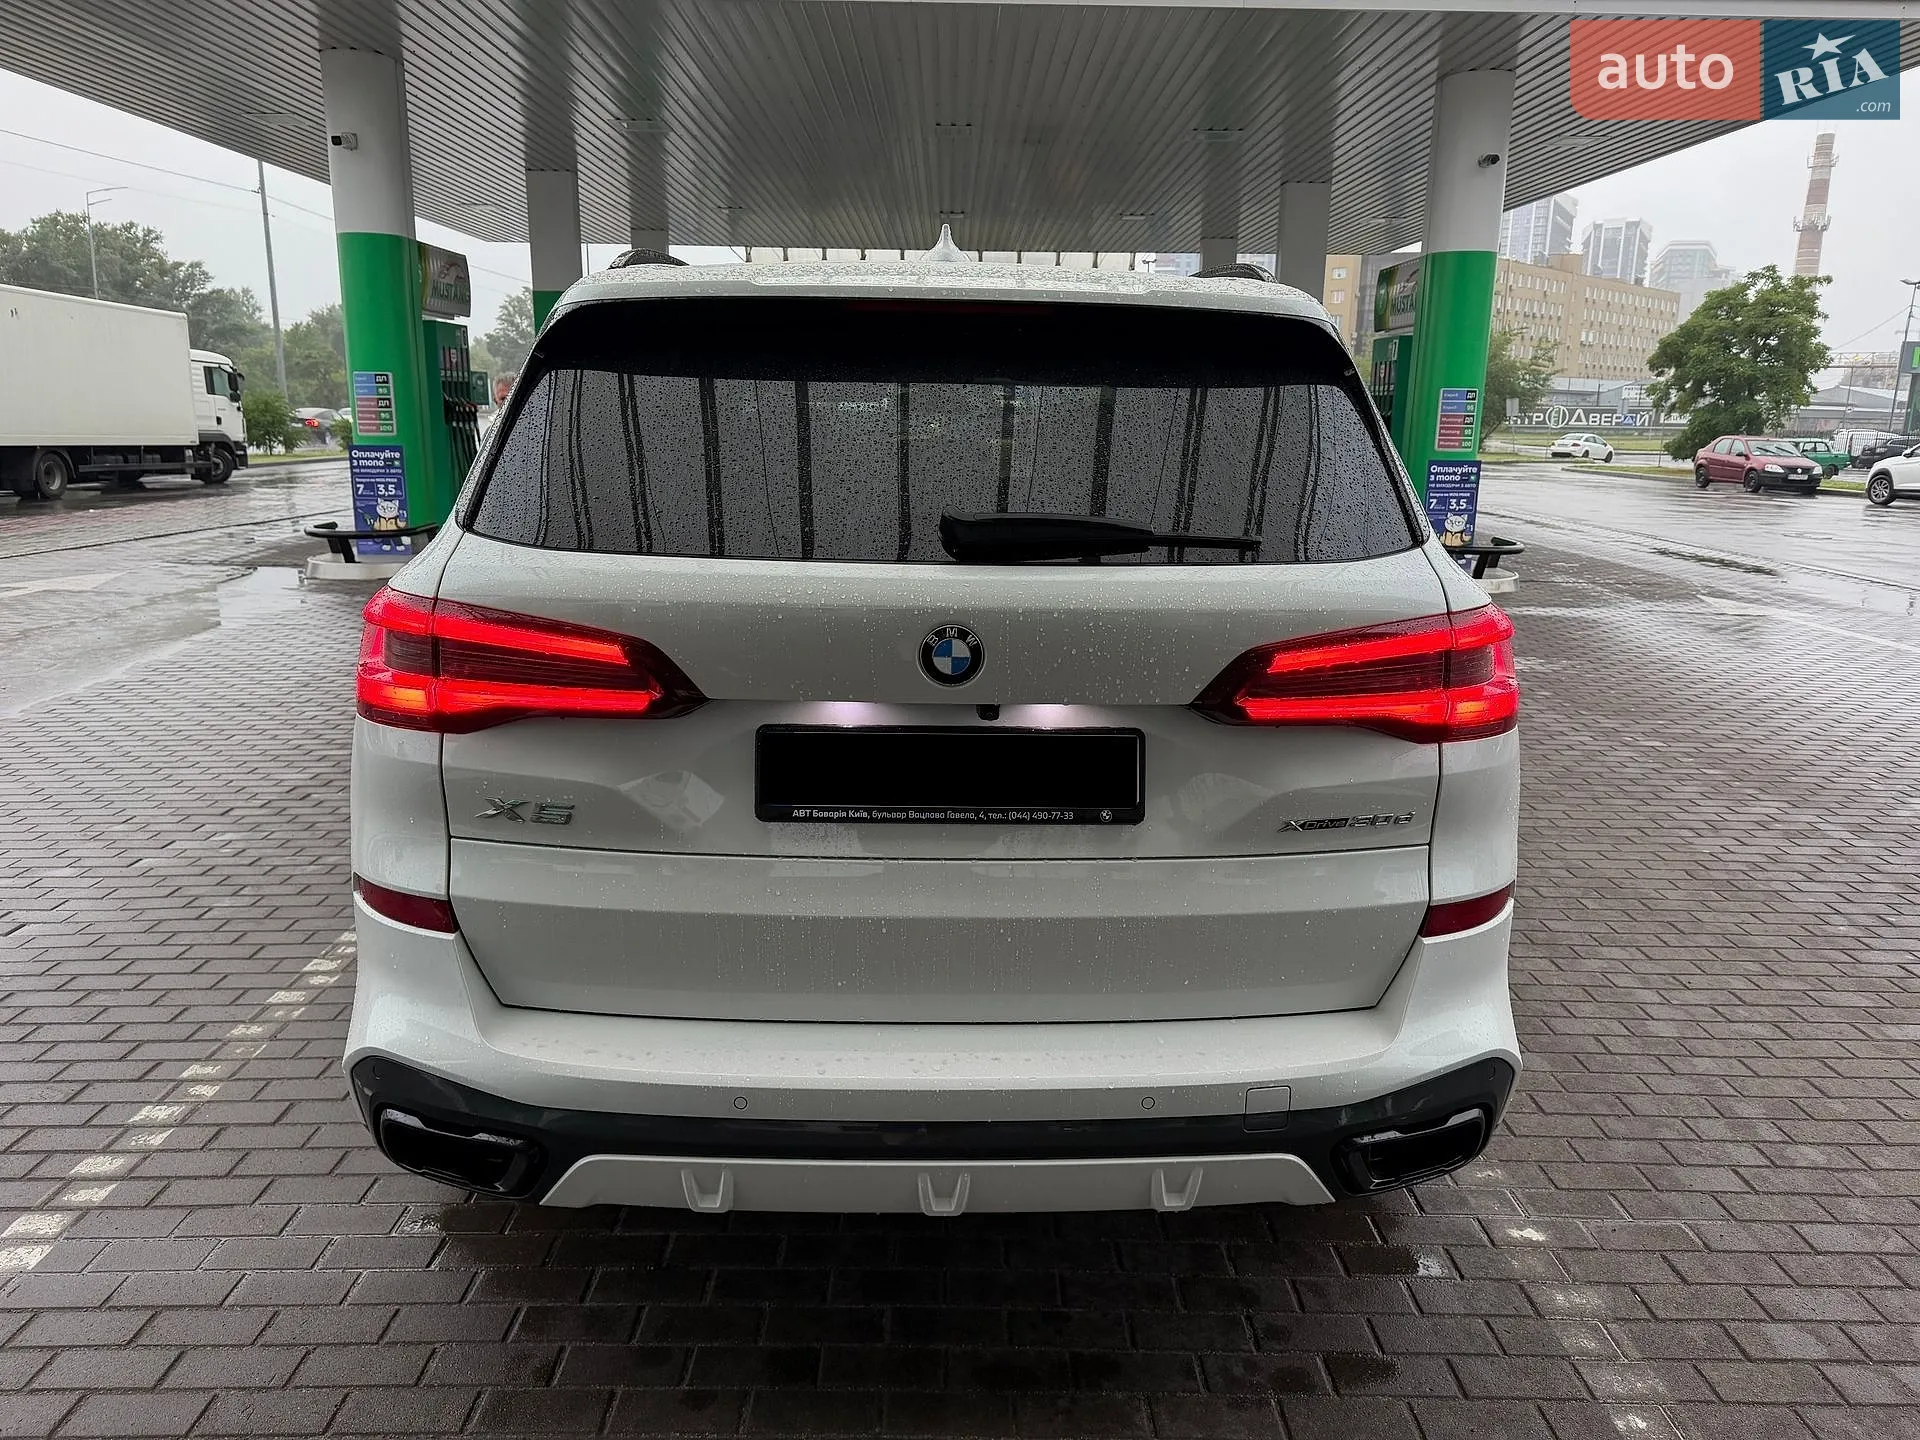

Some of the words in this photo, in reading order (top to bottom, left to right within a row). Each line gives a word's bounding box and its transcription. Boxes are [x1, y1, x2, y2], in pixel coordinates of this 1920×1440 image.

[431, 280, 470, 305] MUSTANG
[1392, 293, 1416, 315] MUSTA
[351, 449, 401, 460] Оплачуйте
[359, 459, 385, 467] mono
[1430, 465, 1478, 475] Оплачуйте
[356, 484, 364, 495] 7
[377, 484, 396, 497] 3,5
[1429, 499, 1437, 510] 7
[1449, 499, 1467, 511] 3,5
[926, 627, 978, 647] BMW
[474, 796, 577, 825] X5
[792, 809, 812, 818] АВТ
[812, 809, 847, 820] Баварія
[848, 809, 870, 820] Київ,
[872, 810, 907, 820] бульвар
[908, 810, 945, 820] Вацлава
[978, 811, 987, 820] 4,
[988, 812, 1007, 820] тел.:
[1008, 811, 1030, 821] (044)
[1032, 811, 1074, 820] 490-77-33
